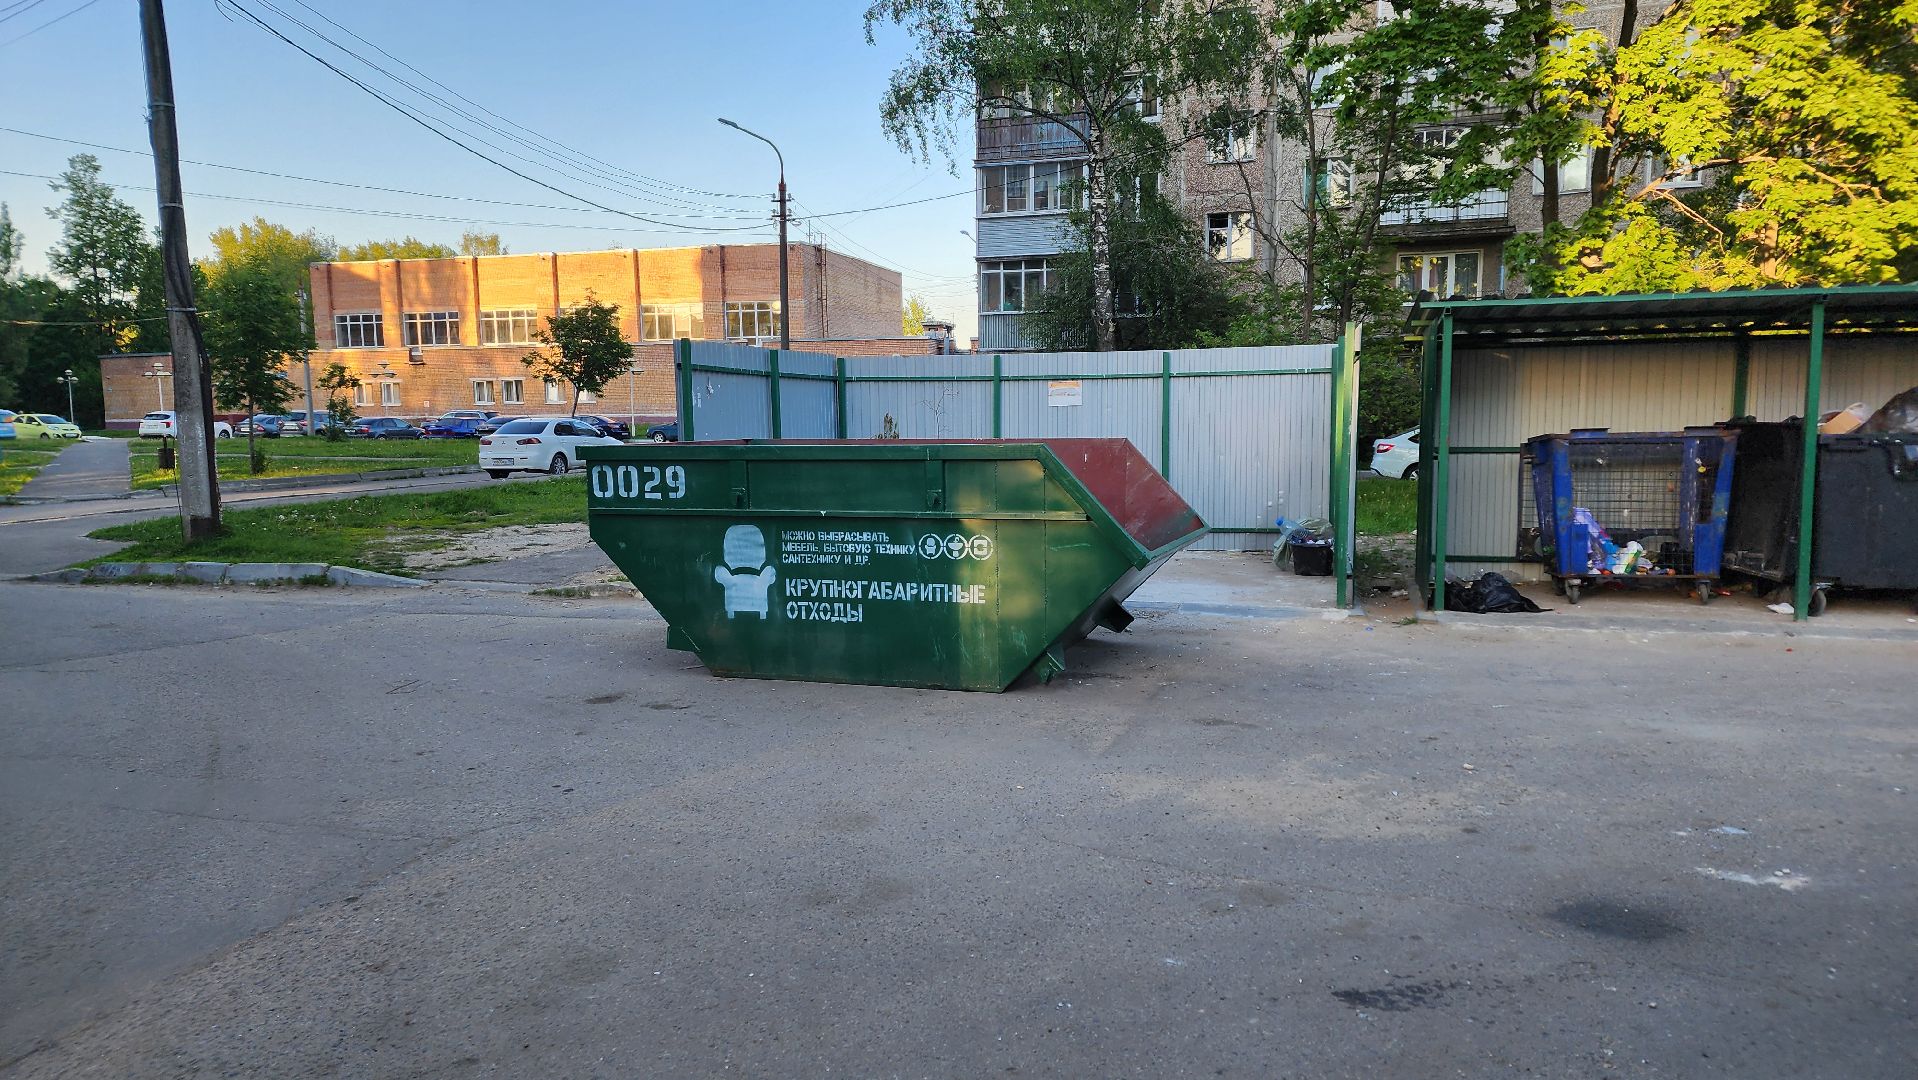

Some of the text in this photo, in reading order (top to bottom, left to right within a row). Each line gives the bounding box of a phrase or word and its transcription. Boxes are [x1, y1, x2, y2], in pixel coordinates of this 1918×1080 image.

[592, 465, 685, 499] 0029
[781, 530, 889, 543] МОЖНО ВЫБРАСЫВАТЬ
[782, 542, 918, 556] МЕБЕЛЬ, БЫТОВУЮ ТЕХНИКУ,
[782, 553, 871, 566] САНТЕХНИКУ И ДР.
[785, 578, 986, 604] КРУПНОГАБАРИТНЫЕ
[786, 601, 863, 623] ОТХОДЫ
